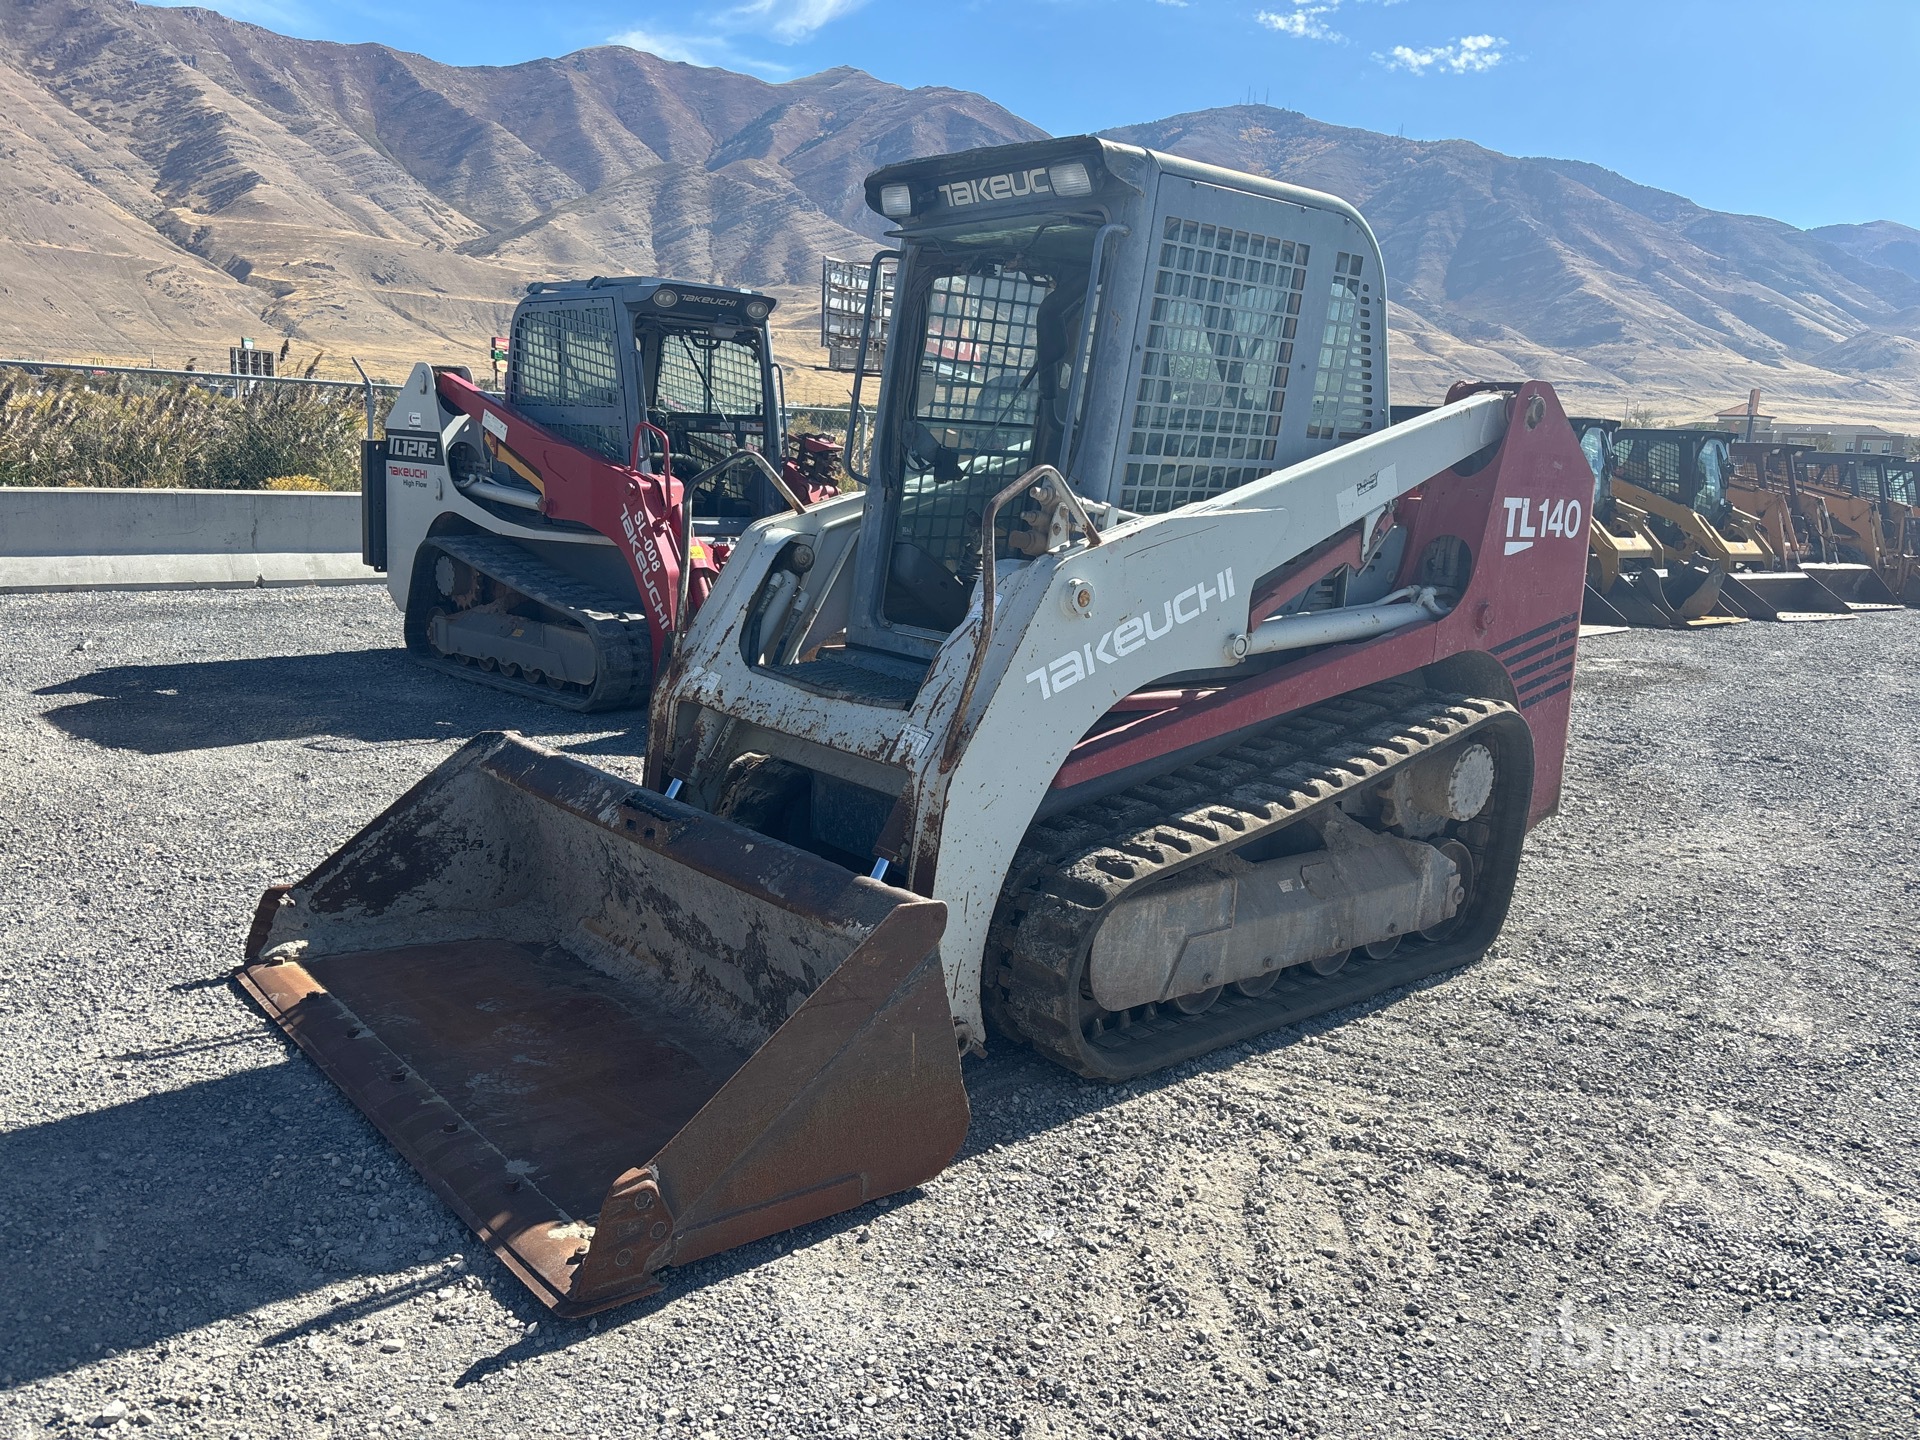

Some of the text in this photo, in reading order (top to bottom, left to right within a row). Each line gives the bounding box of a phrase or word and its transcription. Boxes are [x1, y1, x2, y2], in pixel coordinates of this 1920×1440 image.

[938, 166, 1052, 207] TAKEUC
[403, 479, 428, 488] High Flow
[634, 510, 661, 572] SL-008
